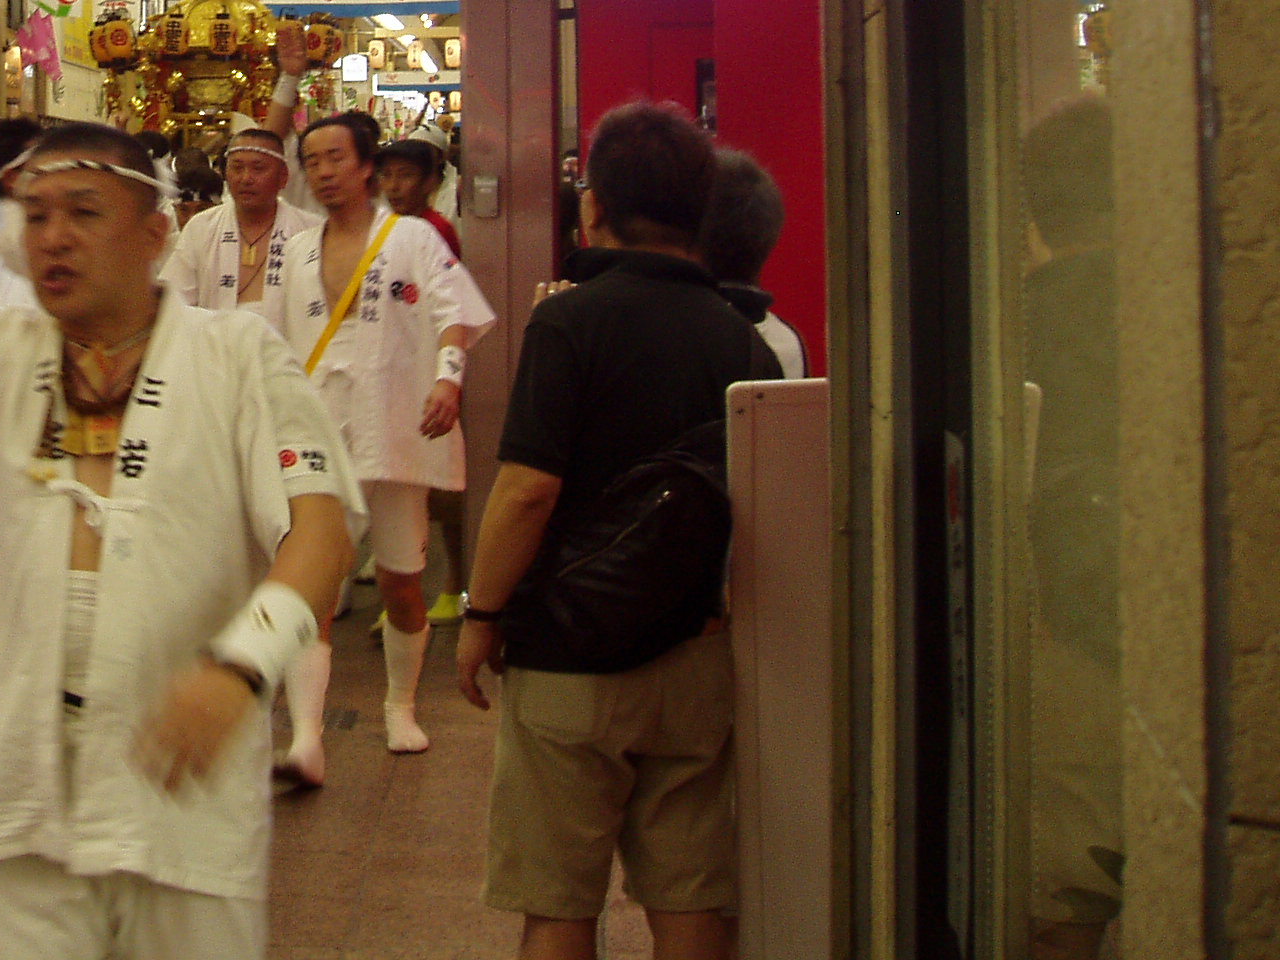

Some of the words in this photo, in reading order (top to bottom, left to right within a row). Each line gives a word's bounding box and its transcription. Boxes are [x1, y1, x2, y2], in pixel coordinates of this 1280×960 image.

[266, 229, 287, 287] 八坂神社
[120, 376, 166, 478] 三若
